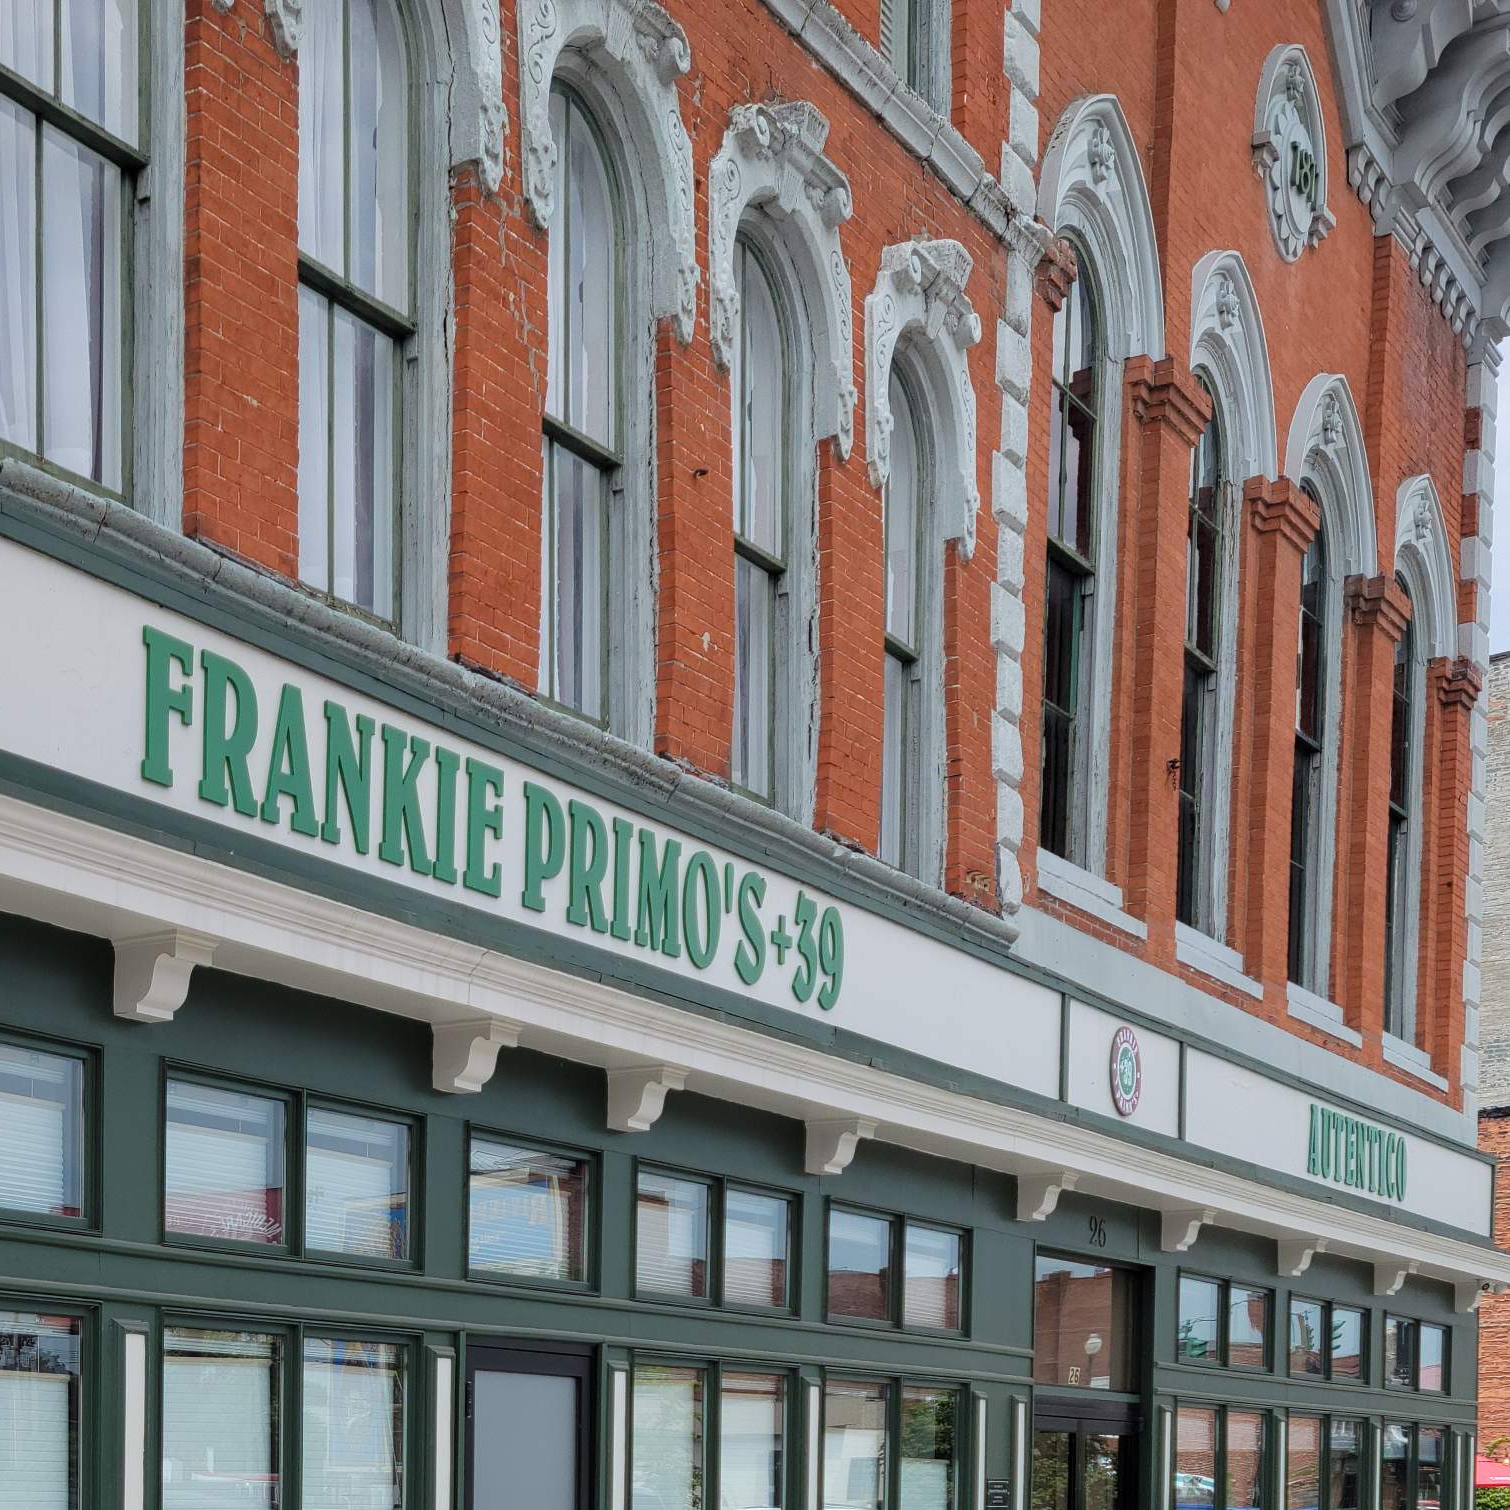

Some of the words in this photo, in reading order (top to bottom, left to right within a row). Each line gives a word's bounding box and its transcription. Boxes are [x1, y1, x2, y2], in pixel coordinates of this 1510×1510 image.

[141, 624, 505, 898] FRANKIE
[1306, 1103, 1408, 1202] AUTENTICO
[1089, 1215, 1107, 1248] 26
[1069, 1367, 1080, 1384] 26
